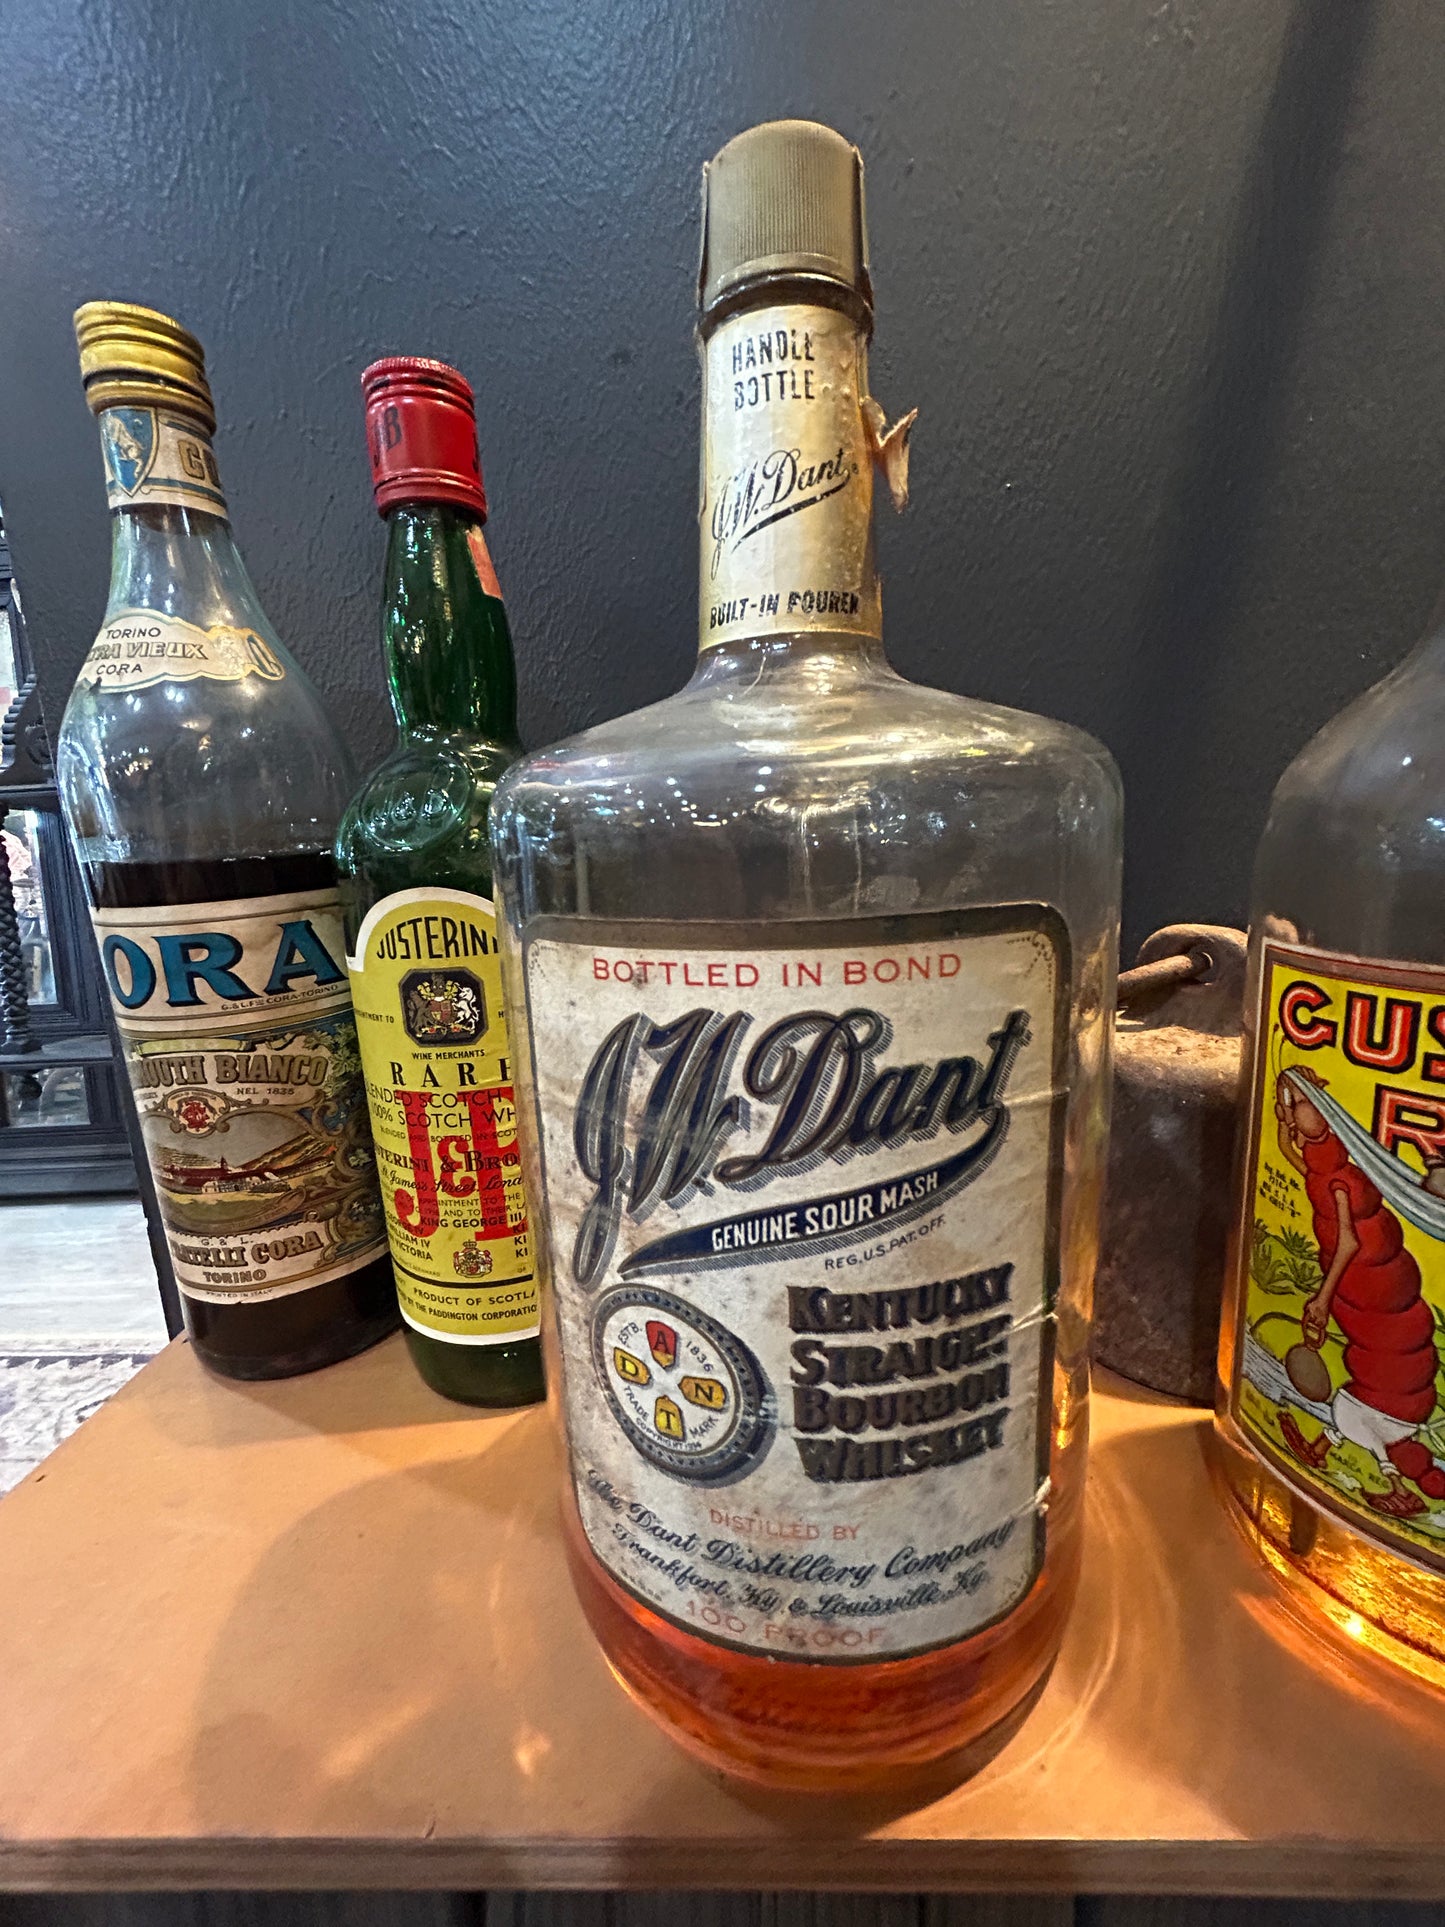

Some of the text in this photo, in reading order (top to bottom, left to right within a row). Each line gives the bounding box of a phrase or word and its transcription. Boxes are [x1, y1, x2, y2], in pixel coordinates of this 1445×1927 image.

[732, 329, 815, 375] HANDLE
[734, 369, 815, 411] BOTTLE
[709, 592, 780, 630] BUILT-IN
[106, 627, 162, 639] TORINO
[127, 641, 209, 660] VIEUX
[96, 663, 143, 675] CORA
[593, 953, 962, 988] BOTTLED IN BOND
[411, 1049, 486, 1060] WINE MERCHANTS
[215, 1054, 329, 1086] BIANCO
[236, 1088, 295, 1096] NEL 1835
[419, 1089, 502, 1109] SCOTCH
[398, 1110, 473, 1129] SCOTCH
[440, 1155, 458, 1173] &
[421, 1211, 523, 1228] KING GEORGE III
[443, 1209, 464, 1218] AND
[467, 1208, 481, 1217] TO
[712, 1171, 938, 1253] GENUINE SOUR MASH
[251, 1230, 324, 1265] CORA
[421, 1238, 430, 1248] IV
[203, 1269, 267, 1284] TORINO
[413, 1287, 460, 1306] PRODUCT
[466, 1297, 482, 1306] OF
[428, 1307, 479, 1321] PADDINGTON
[685, 1340, 714, 1373] 1836
[792, 1362, 1012, 1435] BOURBON
[623, 1386, 719, 1439] TRADE MARK
[709, 1507, 862, 1541] DISTILLED BY
[627, 1502, 698, 1553] Dant
[701, 1538, 876, 1588] Distillery
[884, 1517, 1017, 1580] Company
[686, 1600, 887, 1649] 100 PROOF
